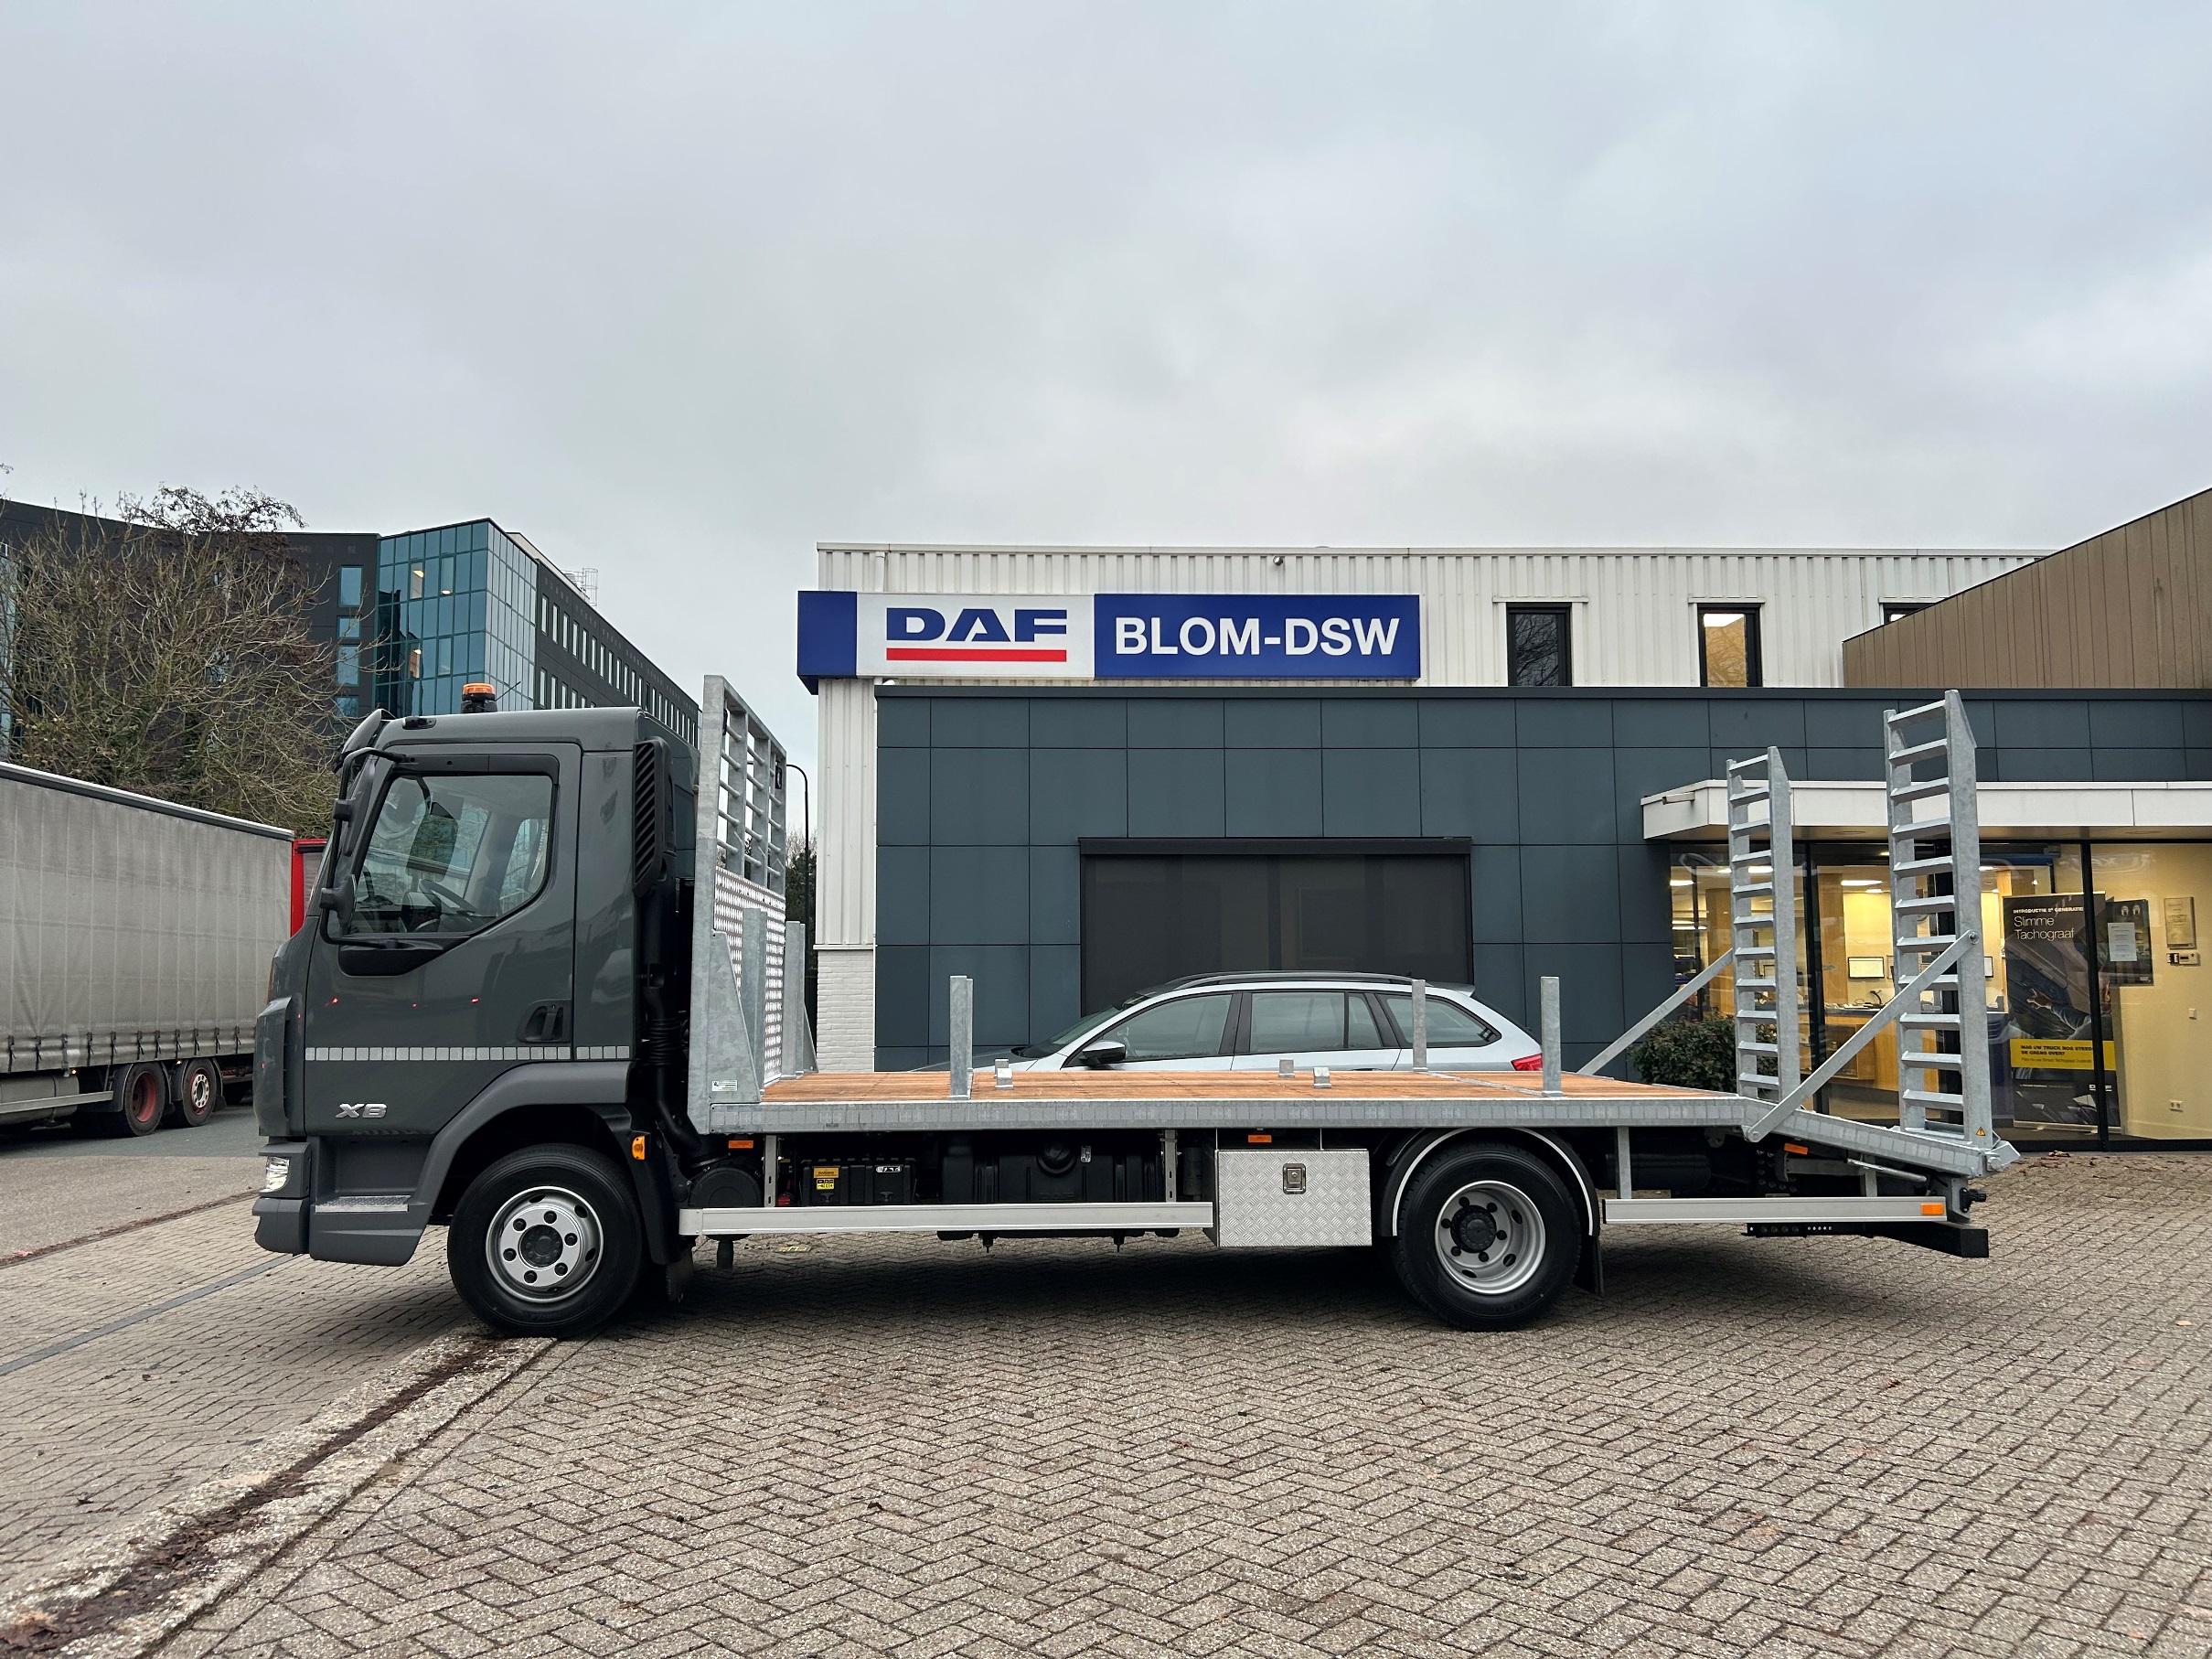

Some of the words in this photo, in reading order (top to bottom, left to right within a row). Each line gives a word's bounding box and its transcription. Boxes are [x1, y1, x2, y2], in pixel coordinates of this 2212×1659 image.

[886, 607, 1067, 642] DAF
[1116, 616, 1400, 656] BLOM-DSW
[2014, 916, 2054, 926] Slimme
[2014, 927, 2074, 941] Tachograaf
[335, 1103, 388, 1118] XB
